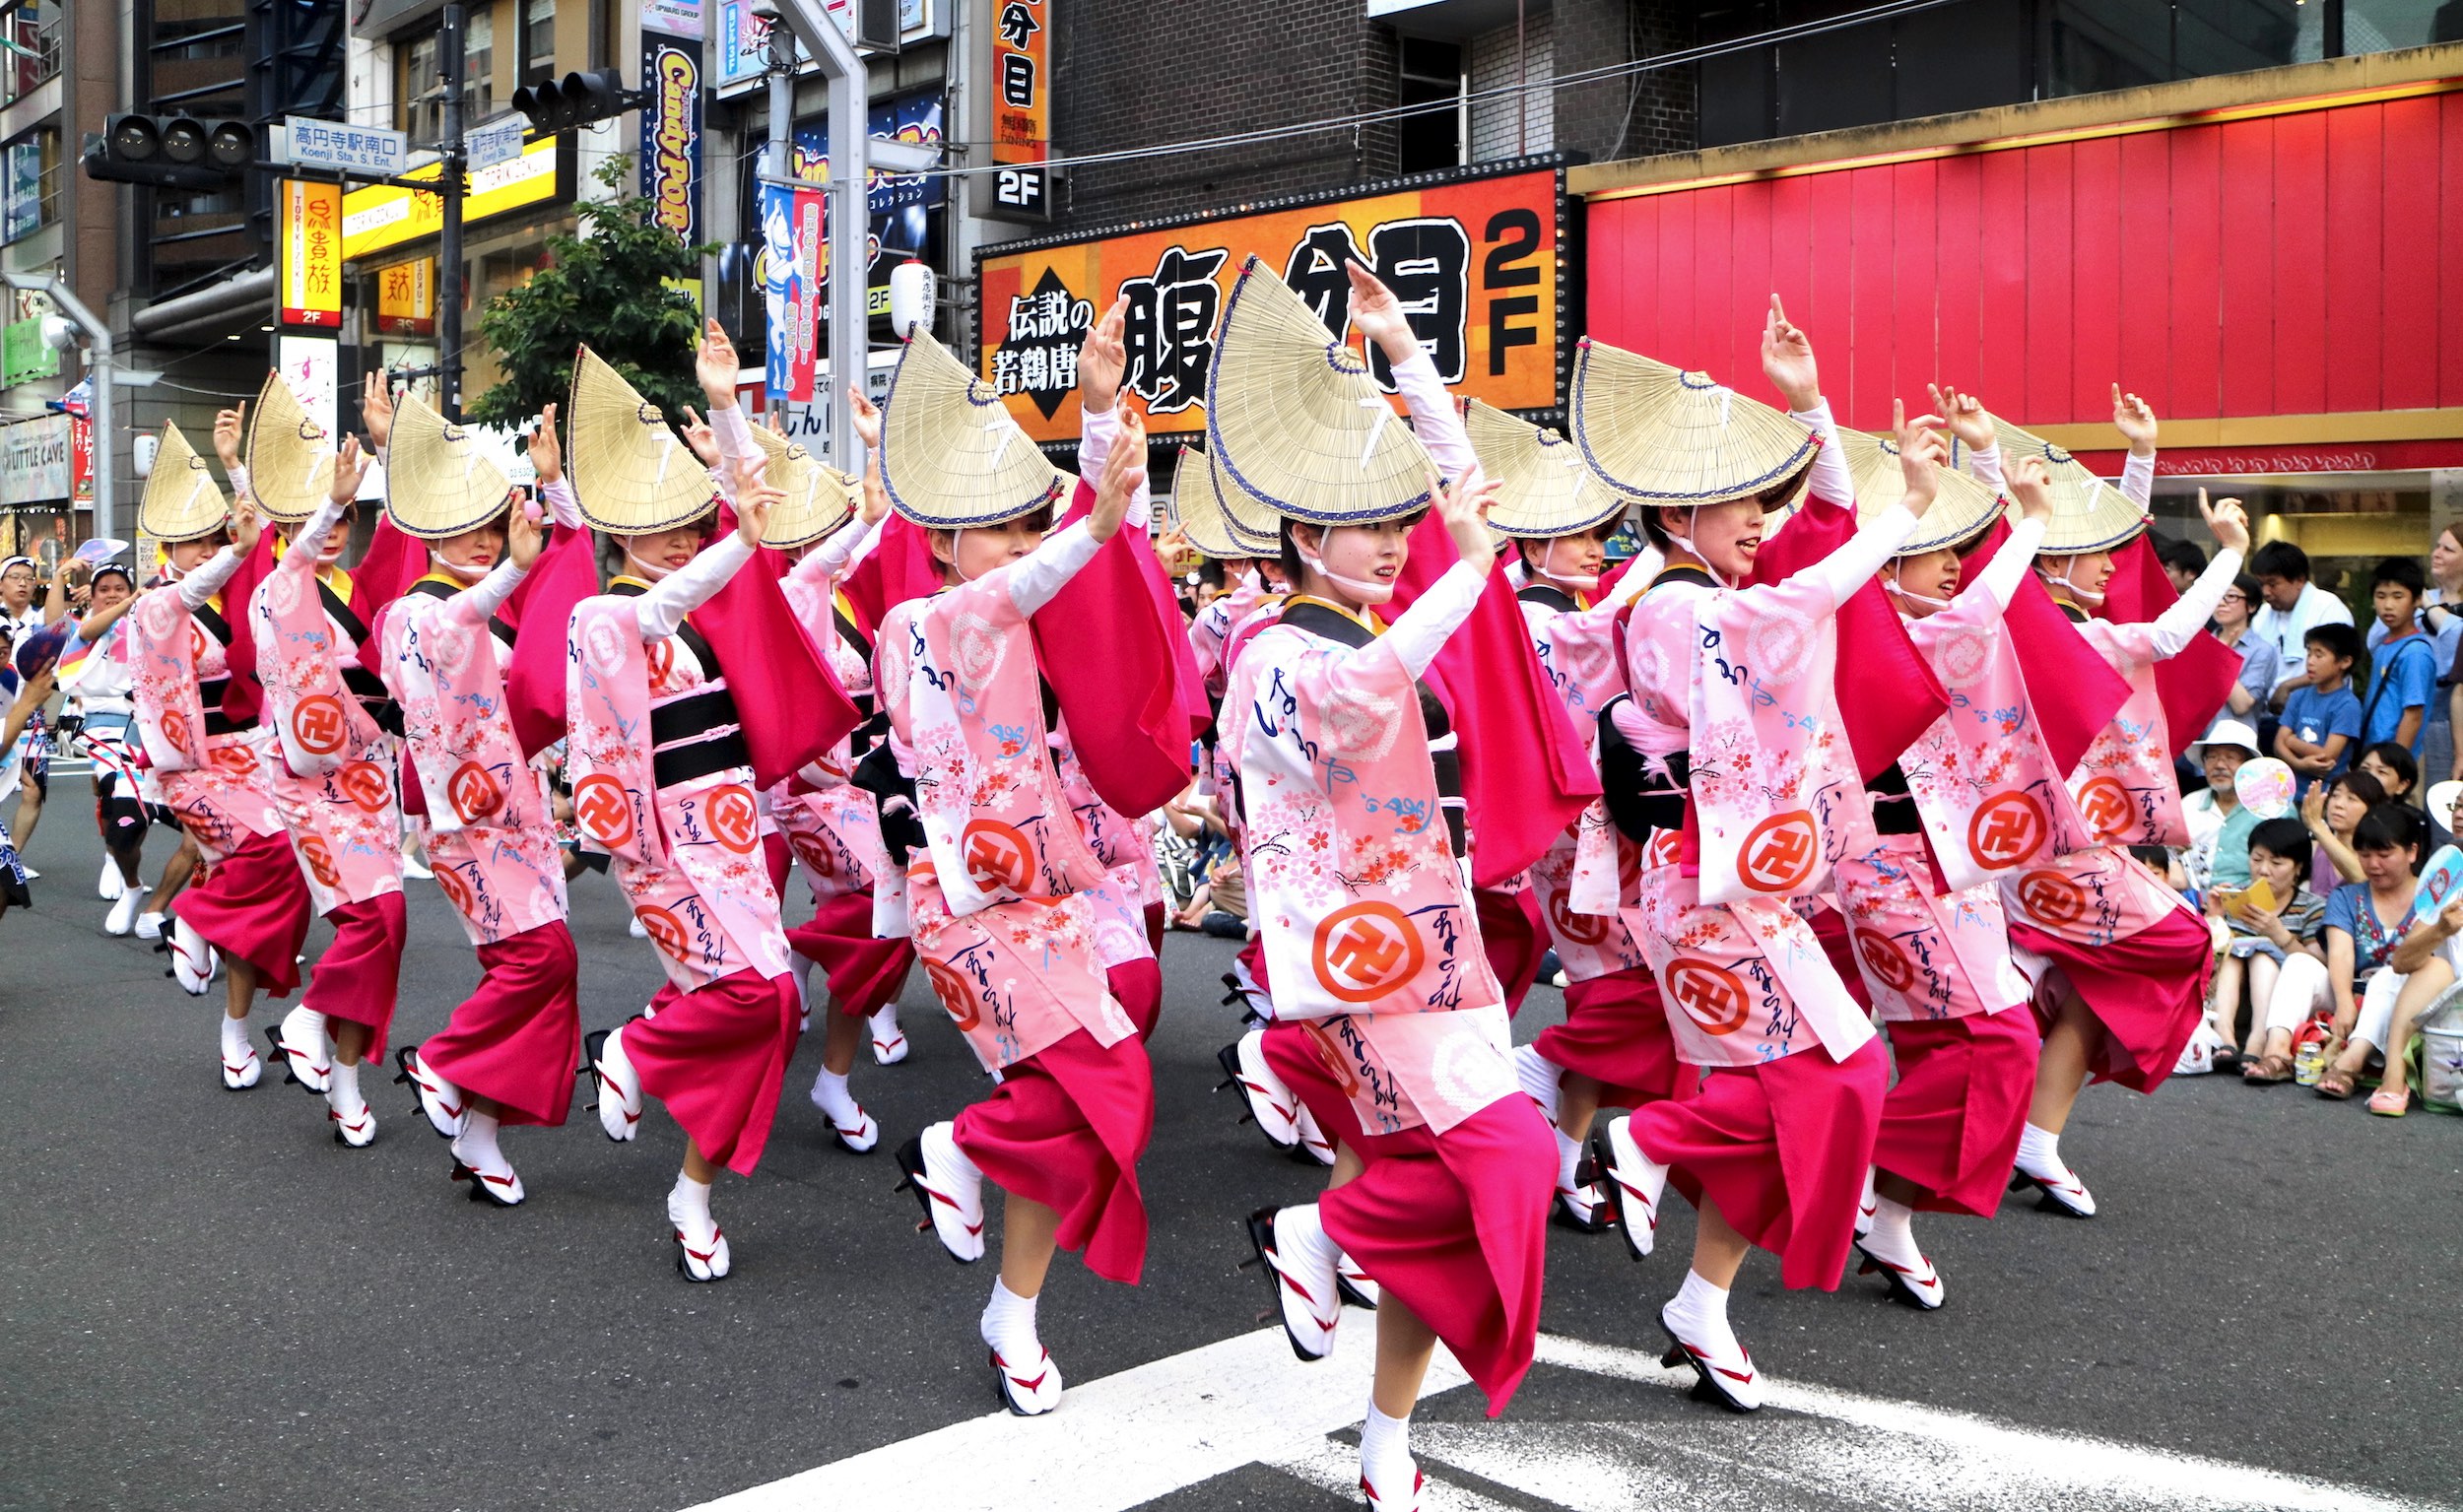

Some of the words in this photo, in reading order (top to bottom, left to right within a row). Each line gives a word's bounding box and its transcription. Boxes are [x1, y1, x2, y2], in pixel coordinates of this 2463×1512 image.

[999, 0, 1041, 108] 分目
[296, 126, 396, 156] 高円寺駅南口
[300, 146, 332, 161] Koenji
[337, 151, 355, 163] Sta.
[360, 154, 369, 164] S.
[374, 157, 392, 167] Ent.
[1001, 133, 1036, 148] DINING
[870, 189, 924, 210] コレクション
[999, 169, 1040, 206] 2F
[869, 290, 889, 309] 2F
[1483, 209, 1542, 376] 2F
[302, 311, 322, 323] 2F
[1008, 290, 1094, 343] 伝説の
[1118, 216, 1471, 414] 腹分目
[991, 341, 1080, 395] 若鶏唐
[12, 447, 38, 470] LITTLE
[41, 441, 64, 466] CAVE
[84, 422, 94, 477] ードゲーム
